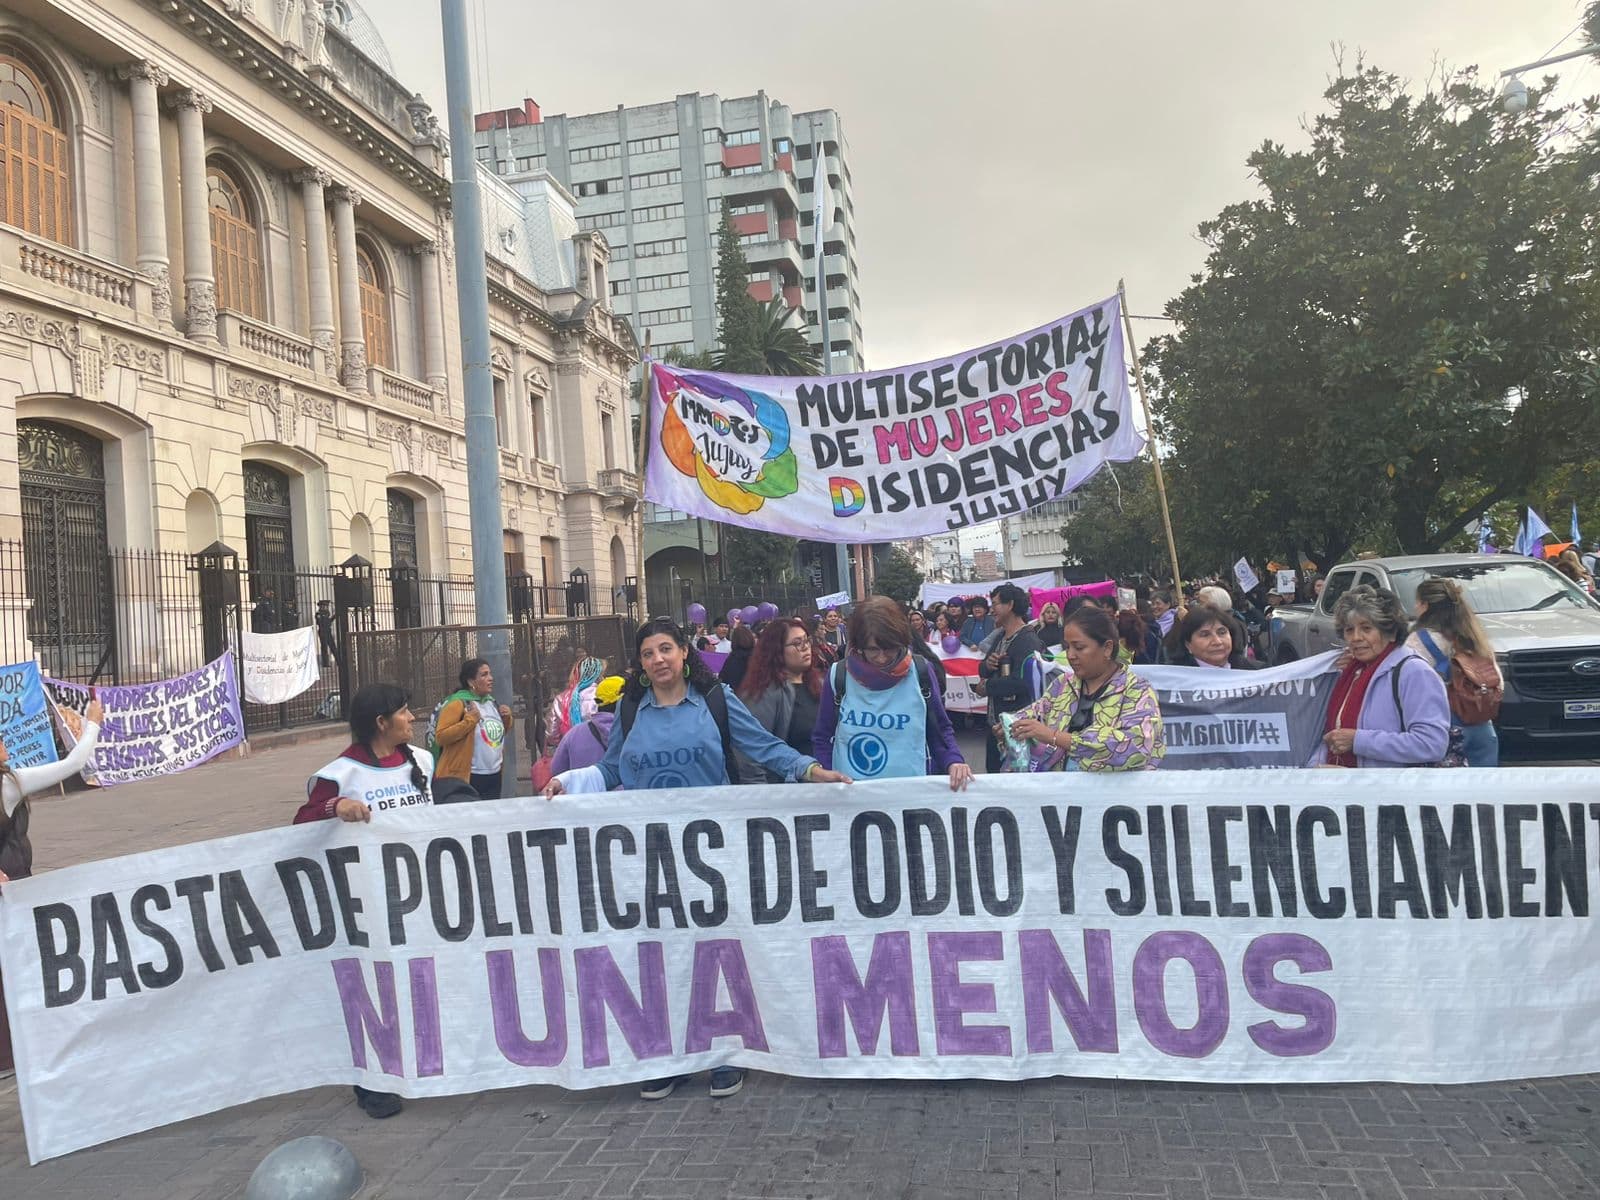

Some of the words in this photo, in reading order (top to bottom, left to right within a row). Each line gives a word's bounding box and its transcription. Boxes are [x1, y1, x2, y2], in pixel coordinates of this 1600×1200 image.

[796, 307, 1110, 427] MULTISECTORIAL
[811, 428, 864, 470] DE
[872, 371, 1073, 465] MUJERES
[1085, 345, 1106, 393] Y
[829, 390, 1120, 517] DISIDENCIAS
[946, 468, 1067, 529] JUJUY
[169, 702, 194, 730] DEL
[195, 681, 231, 716] DOLOR
[172, 706, 237, 754] JUSTICIA
[839, 705, 911, 731] SADOP
[629, 745, 706, 773] SADOP
[378, 798, 397, 811] DE
[399, 792, 432, 808] ABRIL
[32, 869, 281, 1008] BASTA
[274, 845, 370, 951] DE
[381, 818, 731, 946] POLITICAS
[747, 816, 834, 925] DE
[850, 805, 1024, 918] ODIO
[1041, 804, 1083, 914] Y
[331, 957, 445, 1078] NI
[486, 938, 771, 1070] UNA
[811, 928, 1337, 1059] MENOS
